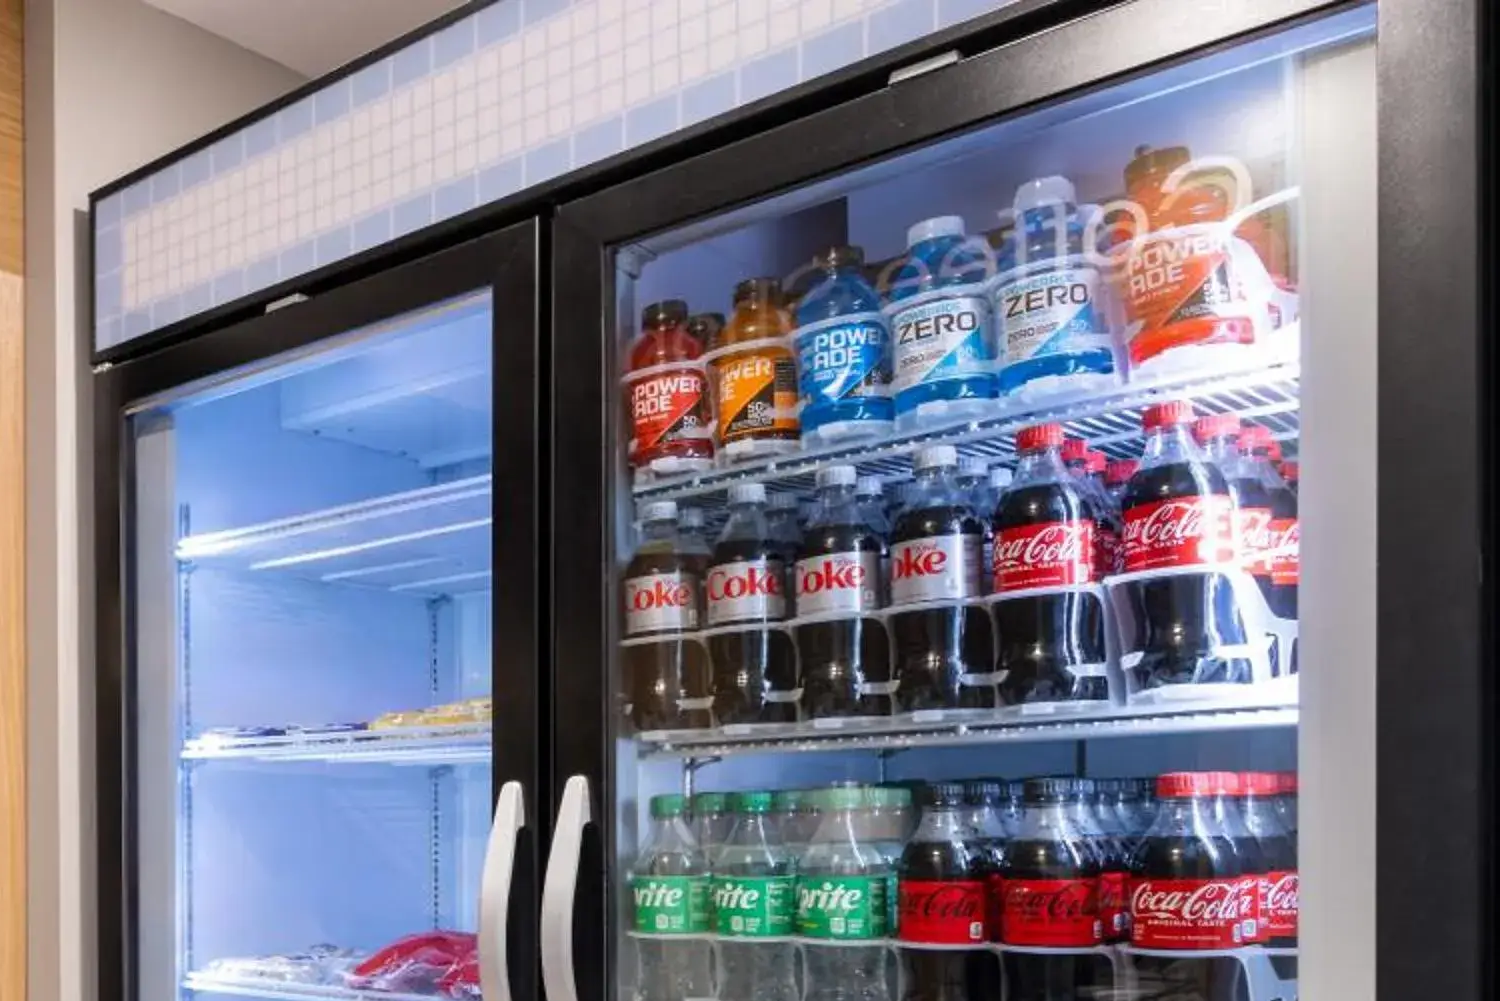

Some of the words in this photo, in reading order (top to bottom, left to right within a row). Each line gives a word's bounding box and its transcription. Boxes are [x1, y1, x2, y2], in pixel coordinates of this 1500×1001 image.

[1005, 283, 1088, 318] ZERO
[815, 327, 881, 353] POWE
[899, 311, 976, 345] ZERO
[815, 345, 863, 371] ADE
[635, 376, 701, 401] POWER
[635, 395, 673, 418] ADE
[1132, 883, 1238, 919] Coca-Cola
